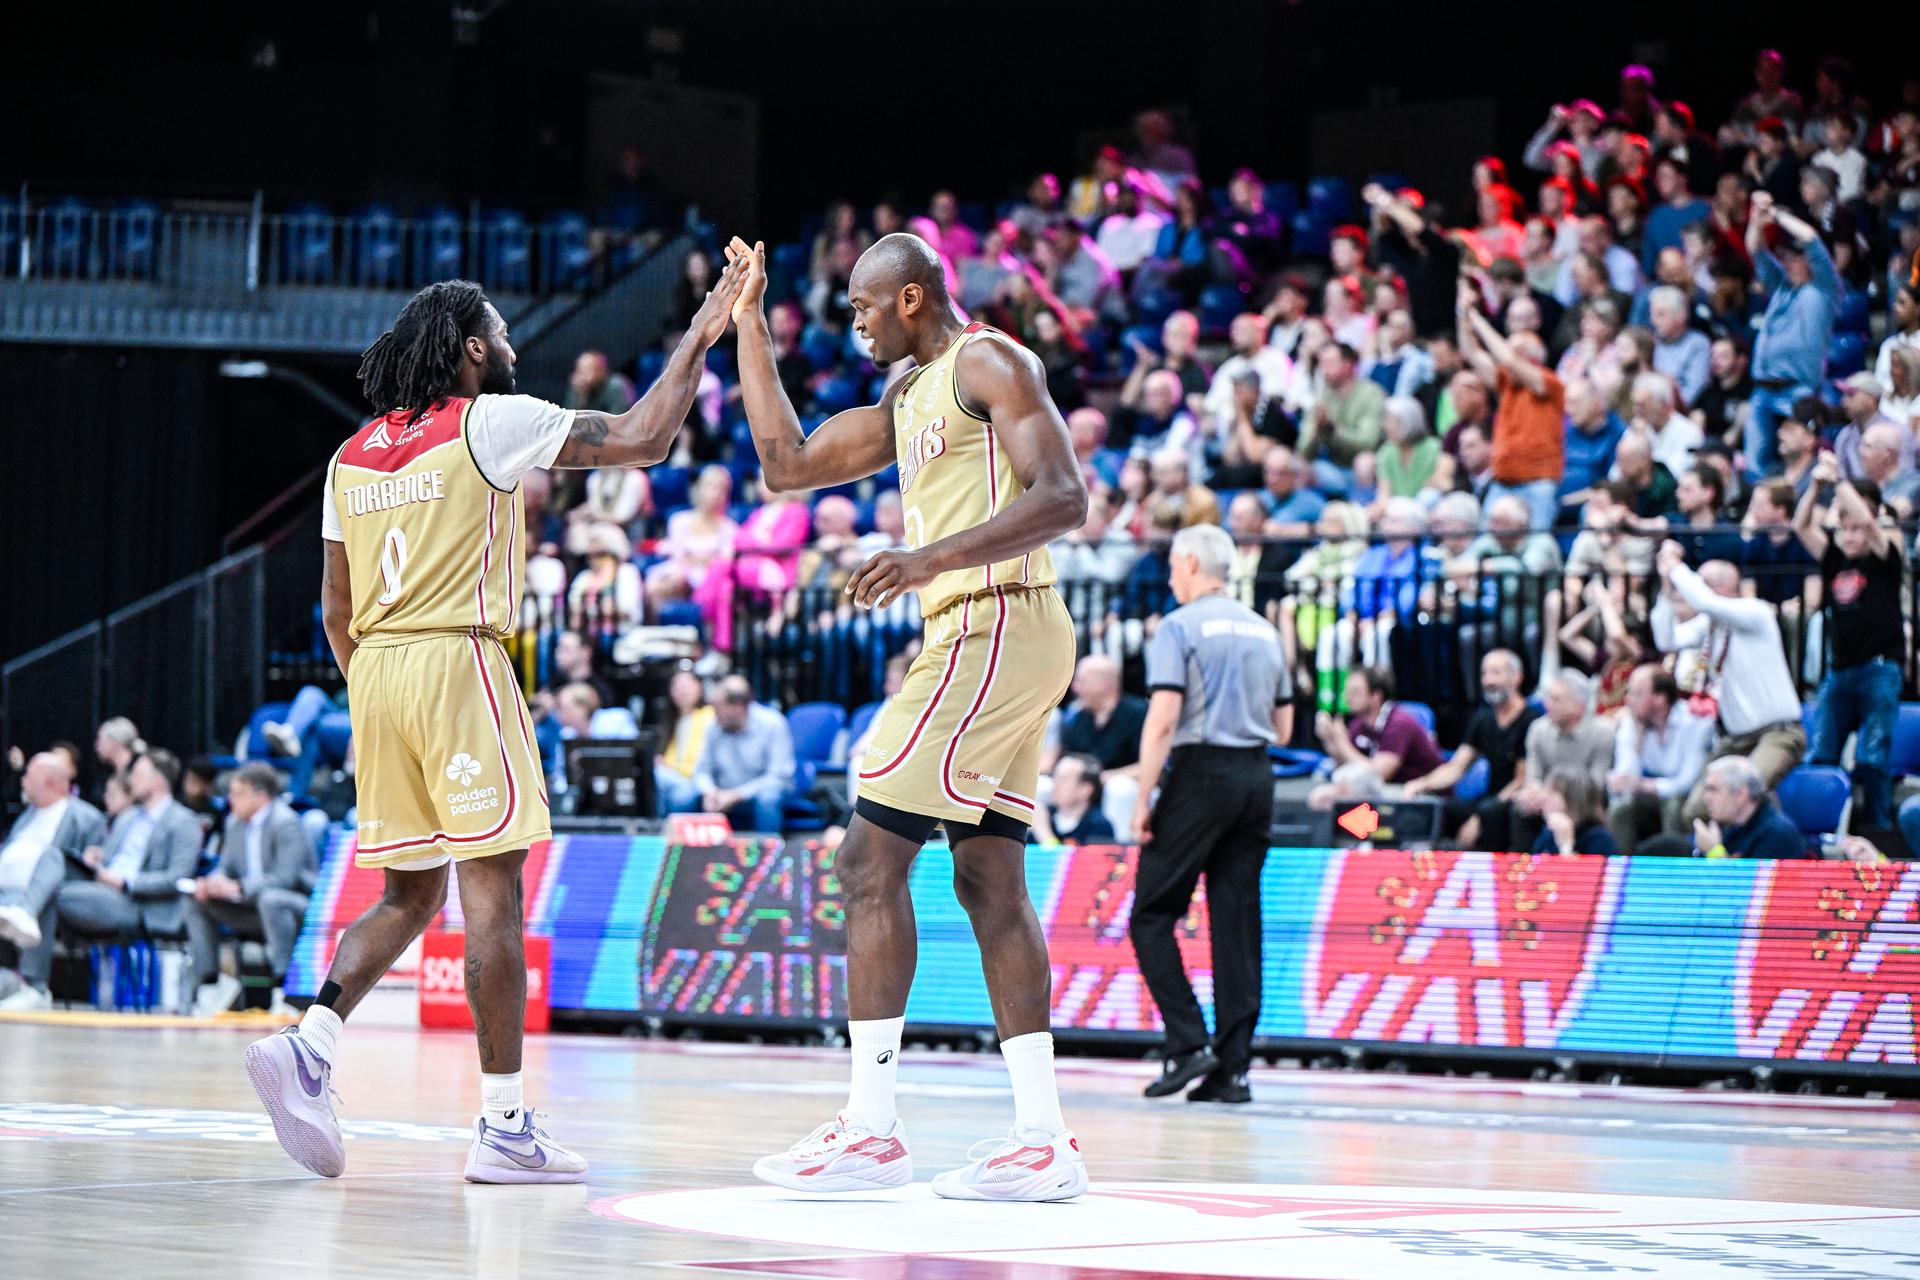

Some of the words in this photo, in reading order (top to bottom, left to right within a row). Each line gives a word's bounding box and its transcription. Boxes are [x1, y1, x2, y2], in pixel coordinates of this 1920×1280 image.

[344, 470, 445, 518] TORRENCE
[378, 527, 407, 606] 0
[447, 786, 497, 804] Golden
